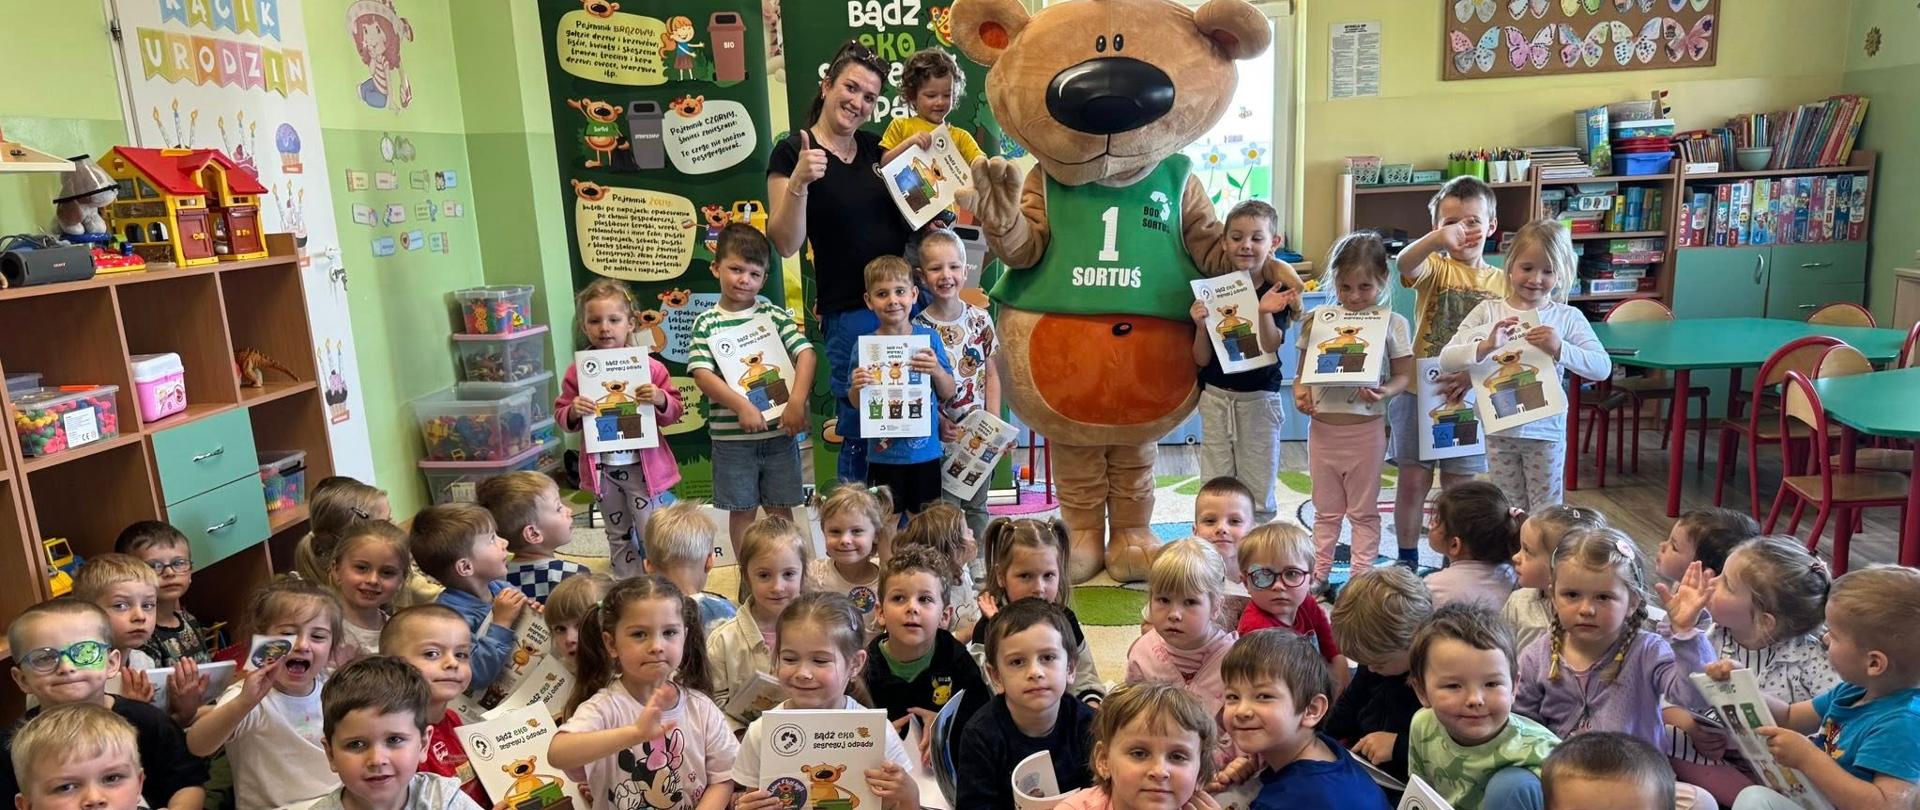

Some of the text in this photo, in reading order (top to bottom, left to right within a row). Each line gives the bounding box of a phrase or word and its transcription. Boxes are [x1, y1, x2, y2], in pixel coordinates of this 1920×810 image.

[576, 20, 611, 31] Pojemnik
[592, 33, 615, 42] drzew
[590, 42, 615, 51] kwiaty
[145, 38, 303, 82] URODZIN
[621, 64, 656, 73] warzywa
[670, 121, 703, 136] Pojemnik
[691, 144, 709, 155] czego
[612, 194, 646, 204] Pojemnik
[1099, 207, 1119, 261] 1
[1072, 266, 1141, 288] SORTUŚ
